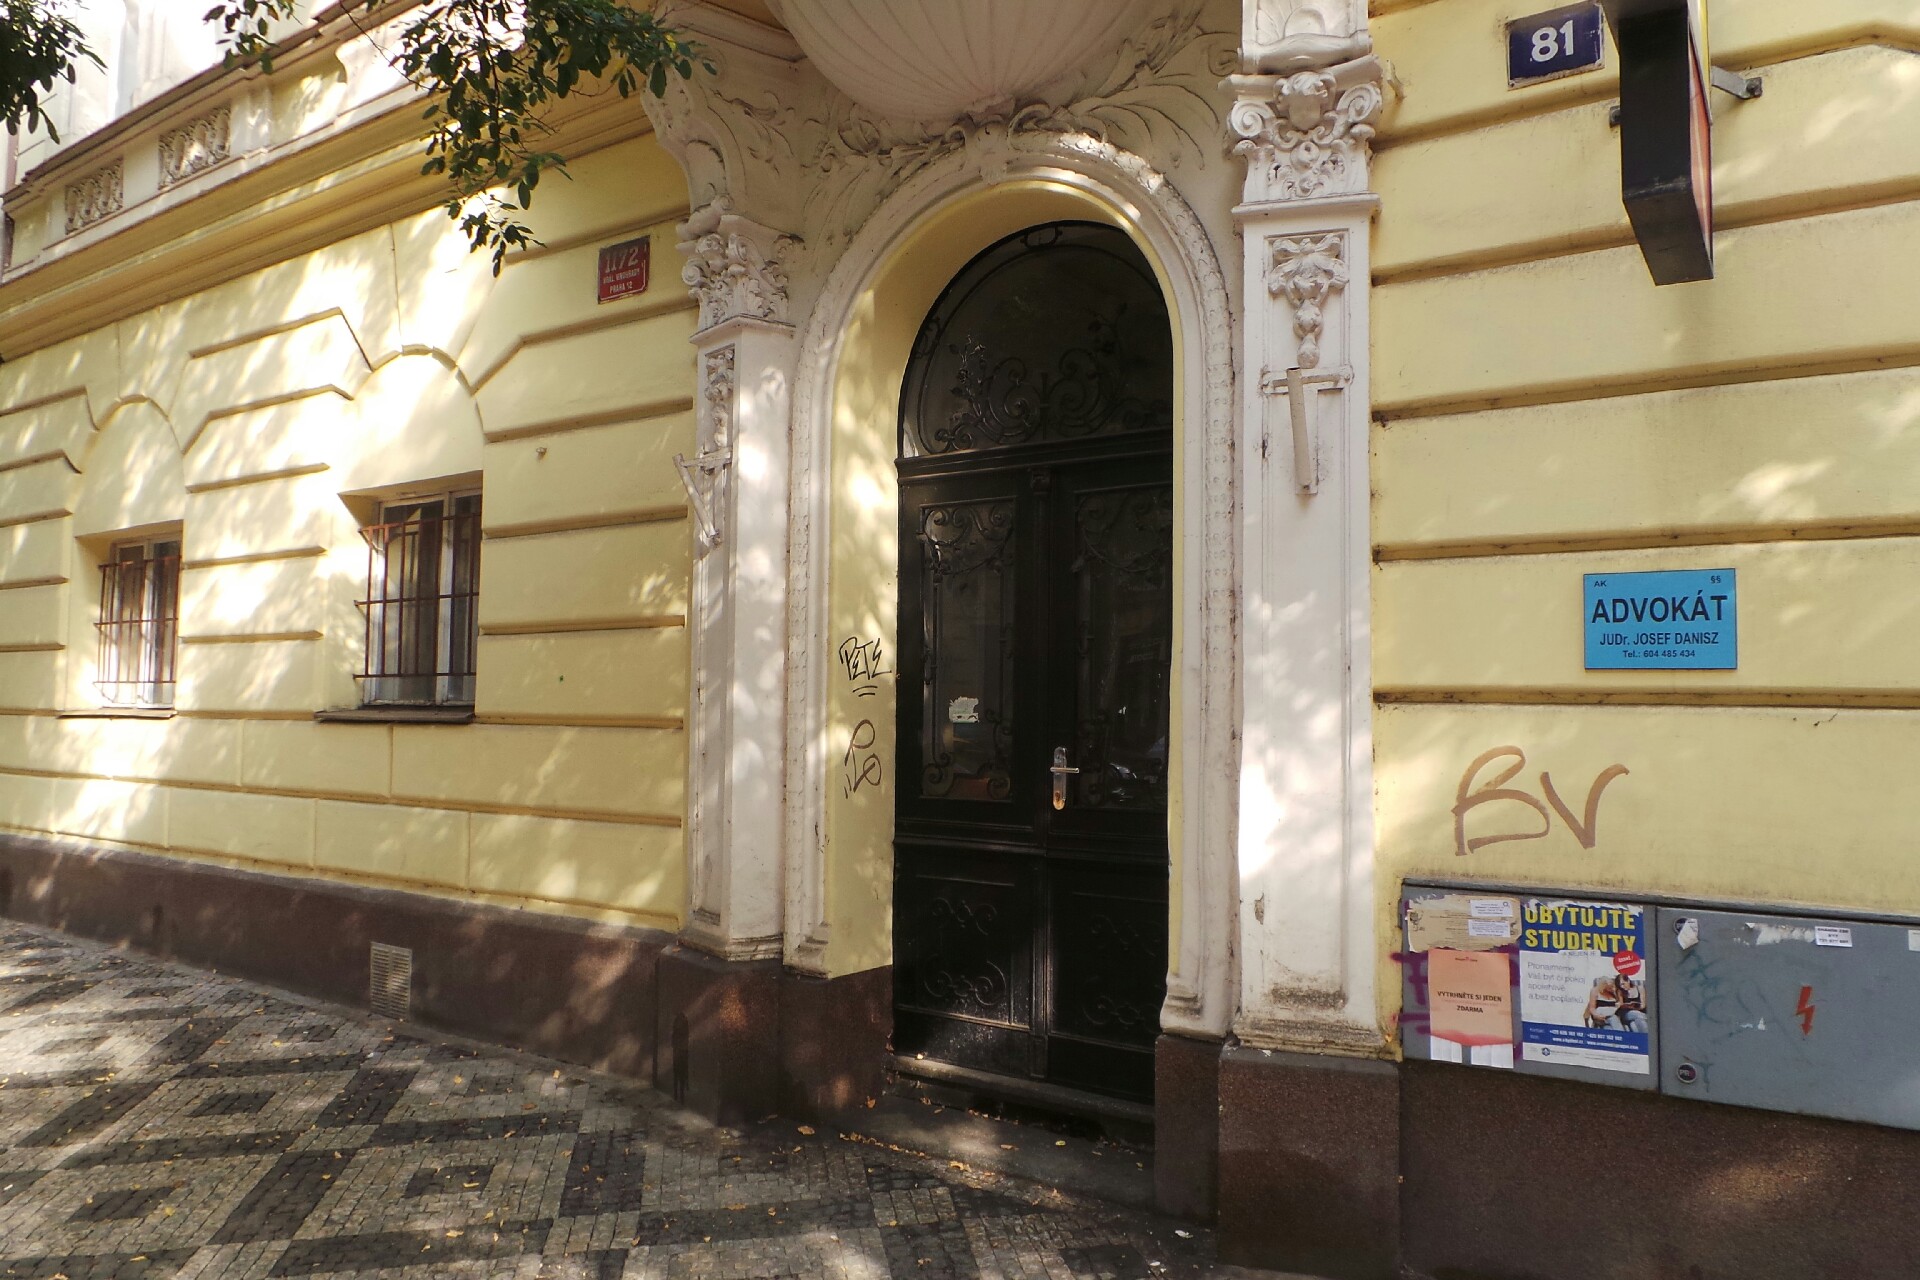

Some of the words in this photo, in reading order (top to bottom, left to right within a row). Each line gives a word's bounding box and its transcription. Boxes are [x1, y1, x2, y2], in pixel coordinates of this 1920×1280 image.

[1530, 20, 1575, 63] 81
[605, 246, 639, 273] 1172
[610, 282, 626, 294] PRAHA
[1594, 580, 1607, 588] AK
[1591, 590, 1728, 624] ADVOKÁT
[1600, 633, 1630, 646] JUDr.
[1633, 632, 1671, 645] JOSEF
[1675, 632, 1719, 645] DANISZ
[1643, 650, 1659, 658] 604
[1661, 650, 1677, 658] 485
[1680, 650, 1696, 658] 434
[1451, 745, 1630, 857] BV
[1524, 905, 1636, 930] UBYTUJTE
[1525, 928, 1636, 954] STUDENTY
[1437, 990, 1474, 1000] VYTRHNĚTE
[1456, 1005, 1483, 1013] ZDARMA
